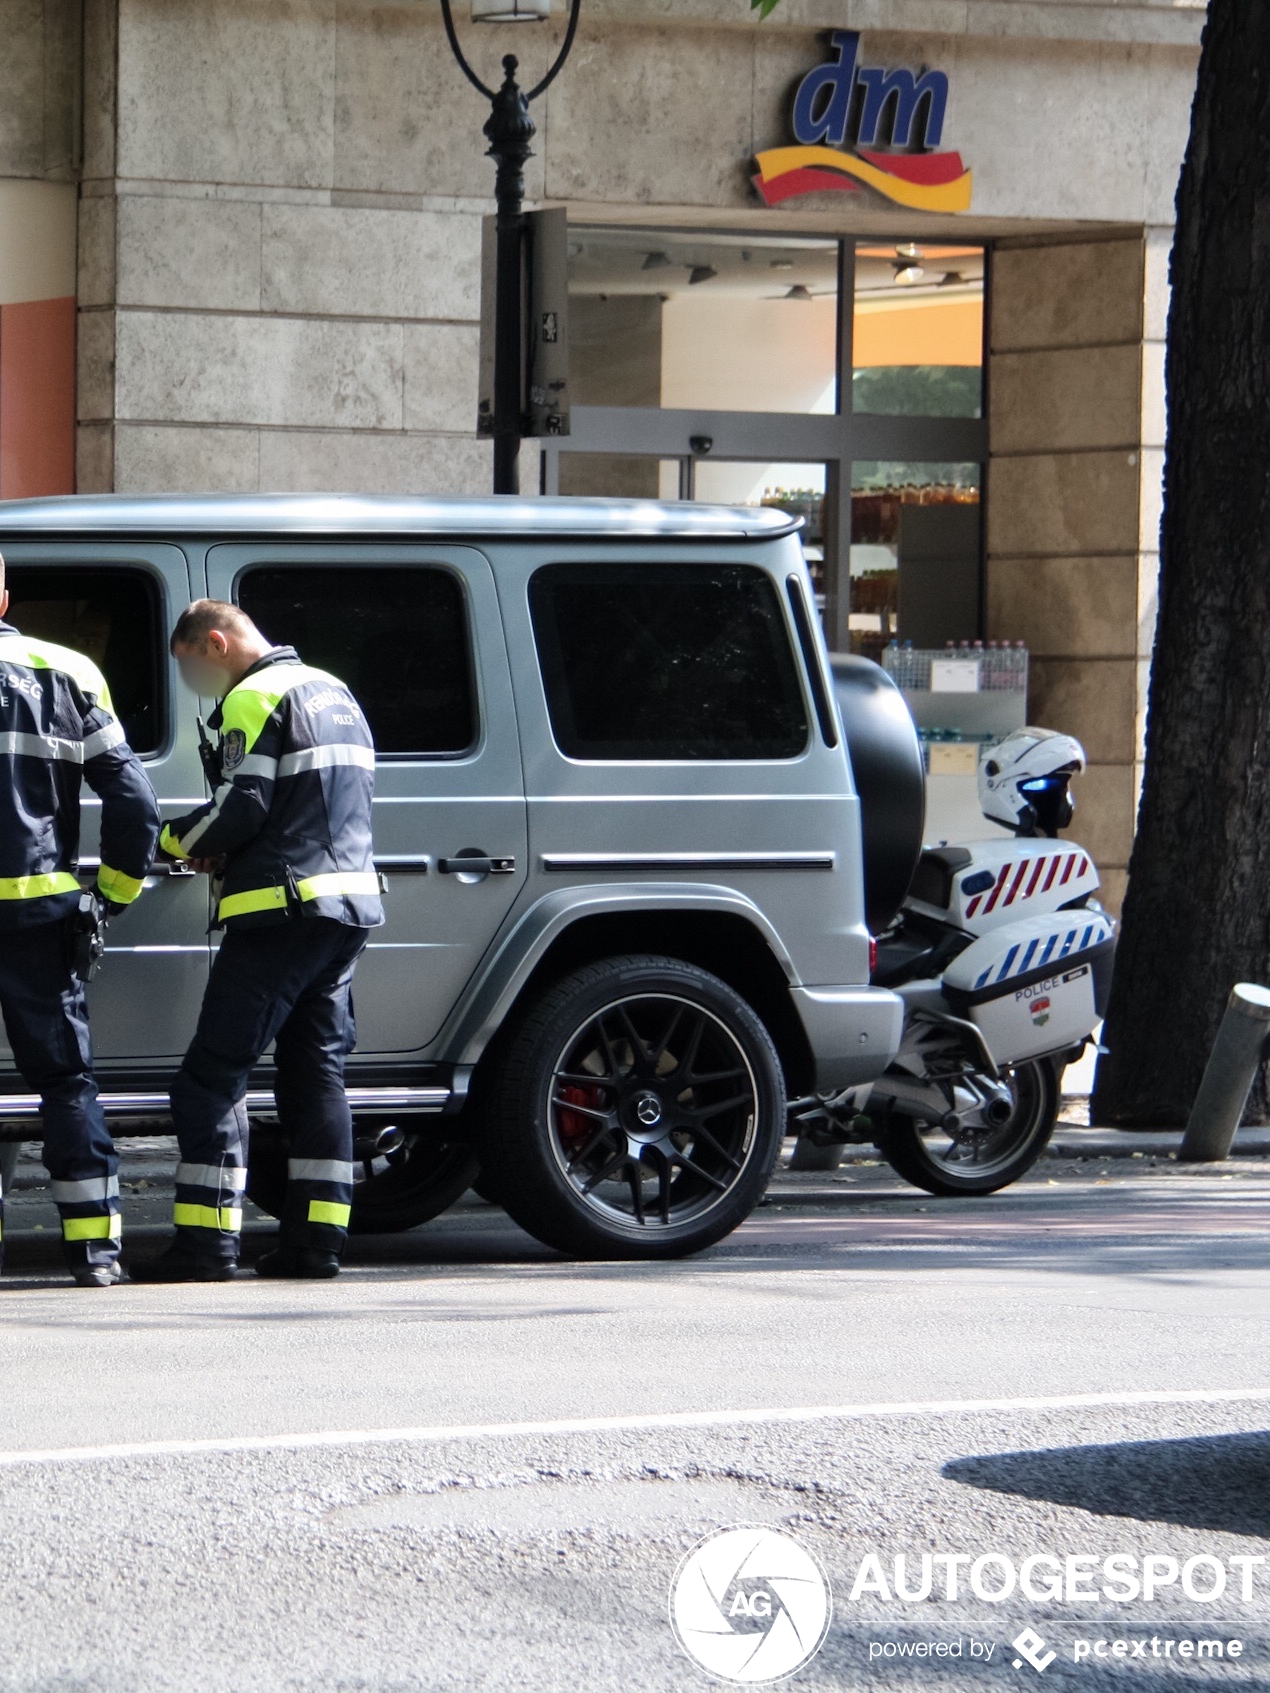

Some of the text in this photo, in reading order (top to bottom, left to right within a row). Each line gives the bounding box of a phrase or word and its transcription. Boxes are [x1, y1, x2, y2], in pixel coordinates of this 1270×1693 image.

[793, 31, 949, 148] dm
[332, 714, 355, 726] POLICE
[1015, 976, 1059, 1002] POLICE
